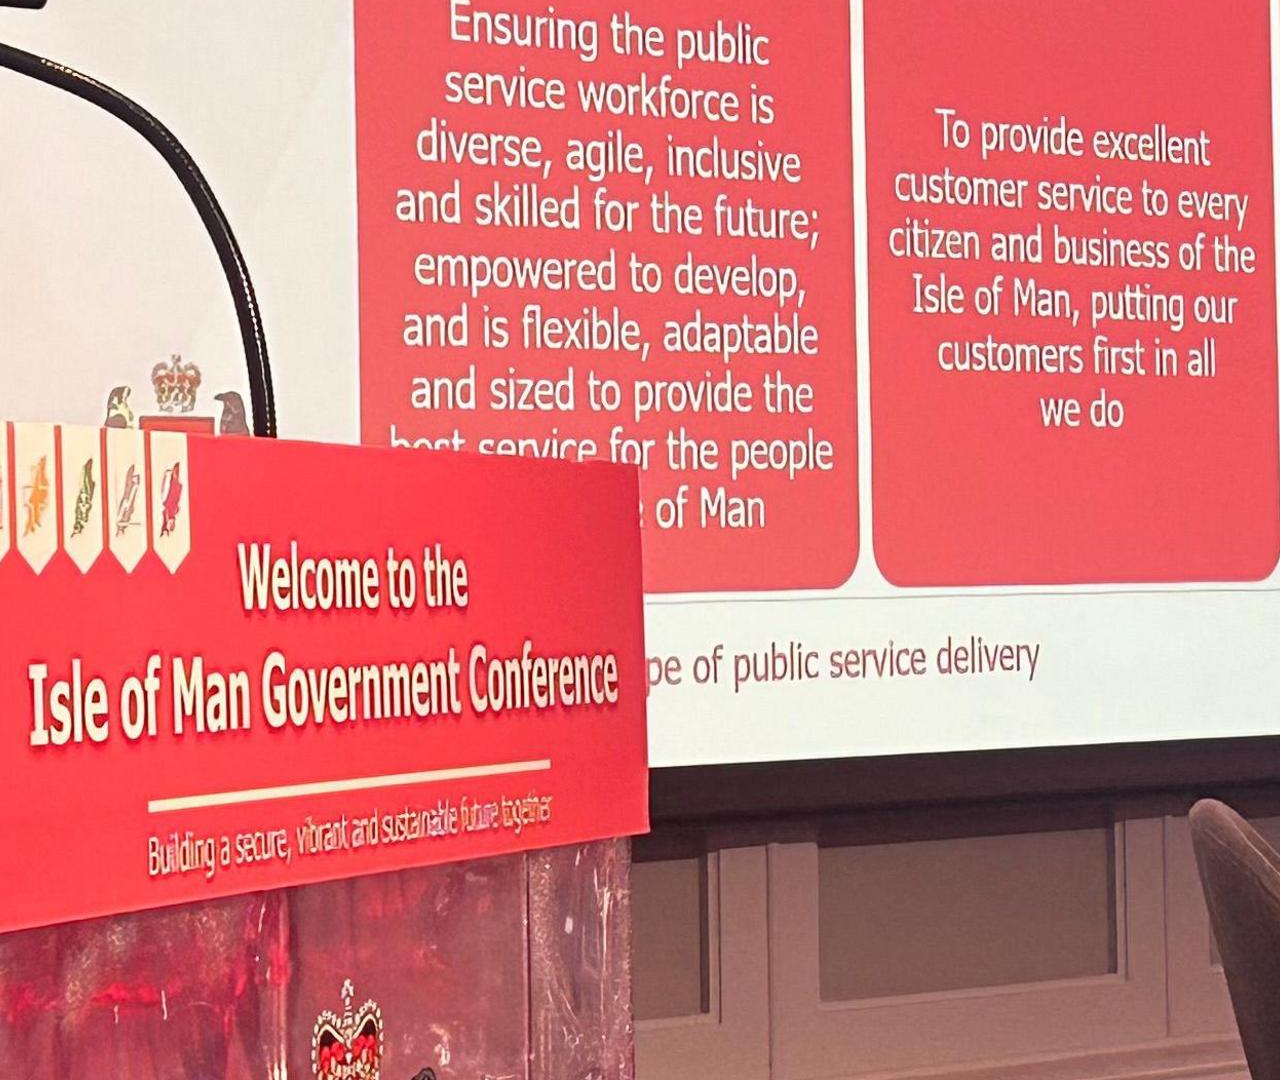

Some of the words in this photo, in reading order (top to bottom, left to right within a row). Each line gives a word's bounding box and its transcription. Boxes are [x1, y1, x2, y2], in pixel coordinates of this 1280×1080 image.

[611, 12, 664, 56] the
[678, 20, 769, 69] public
[446, 66, 565, 109] service
[578, 73, 738, 121] workforce
[751, 84, 774, 124] is
[417, 117, 551, 179] diverse,
[566, 130, 653, 185] agile,
[668, 135, 800, 182] inclusive
[935, 108, 969, 148] To
[982, 116, 1083, 160] provide
[1093, 124, 1210, 166] excellent
[396, 179, 460, 223] and
[476, 181, 580, 229] skilled
[594, 187, 639, 232] for
[651, 191, 702, 235] the
[715, 194, 818, 249] future;
[896, 168, 1028, 208] customer
[1038, 175, 1132, 214] service
[1142, 180, 1168, 216] to
[1178, 191, 1248, 231] every
[890, 217, 979, 259] citizen
[991, 224, 1042, 263] and
[1054, 224, 1169, 268] business
[1179, 233, 1205, 270] of
[1214, 235, 1255, 273] the
[415, 249, 615, 298] empowered
[629, 253, 661, 293] to
[675, 252, 805, 307] develop,
[913, 273, 964, 313] Isle
[975, 275, 1003, 315] of
[1014, 278, 1079, 326] Man,
[1092, 284, 1183, 331] putting
[1194, 296, 1238, 323] our
[404, 303, 467, 346] and
[484, 305, 509, 348] is
[523, 305, 649, 361] flexible,
[664, 310, 818, 363] adaptable
[939, 335, 1083, 373] customers
[1094, 335, 1145, 375] first
[1155, 338, 1177, 376] in
[1188, 338, 1215, 376] all
[412, 365, 475, 409] and
[491, 367, 574, 410] sized
[588, 371, 620, 410] to
[635, 370, 752, 422] provide
[763, 370, 813, 413] the
[1040, 398, 1080, 426] we
[1090, 389, 1124, 427] do
[610, 426, 655, 470] for
[667, 427, 718, 469] the
[732, 428, 833, 480] people
[656, 485, 688, 528] of
[701, 487, 764, 527] Man
[238, 541, 379, 610] Welcome
[387, 546, 415, 608] to
[424, 544, 467, 606] the
[29, 659, 108, 745] Isle
[121, 655, 161, 739] of
[173, 657, 250, 733] Man
[263, 648, 461, 727] Government
[470, 641, 617, 712] Conference
[693, 644, 723, 683] of
[735, 642, 819, 693] public
[830, 640, 926, 678] service
[937, 636, 1039, 681] delivery
[149, 832, 215, 877] Building
[221, 836, 230, 865] a
[236, 829, 291, 863] secure,
[352, 808, 378, 847] and
